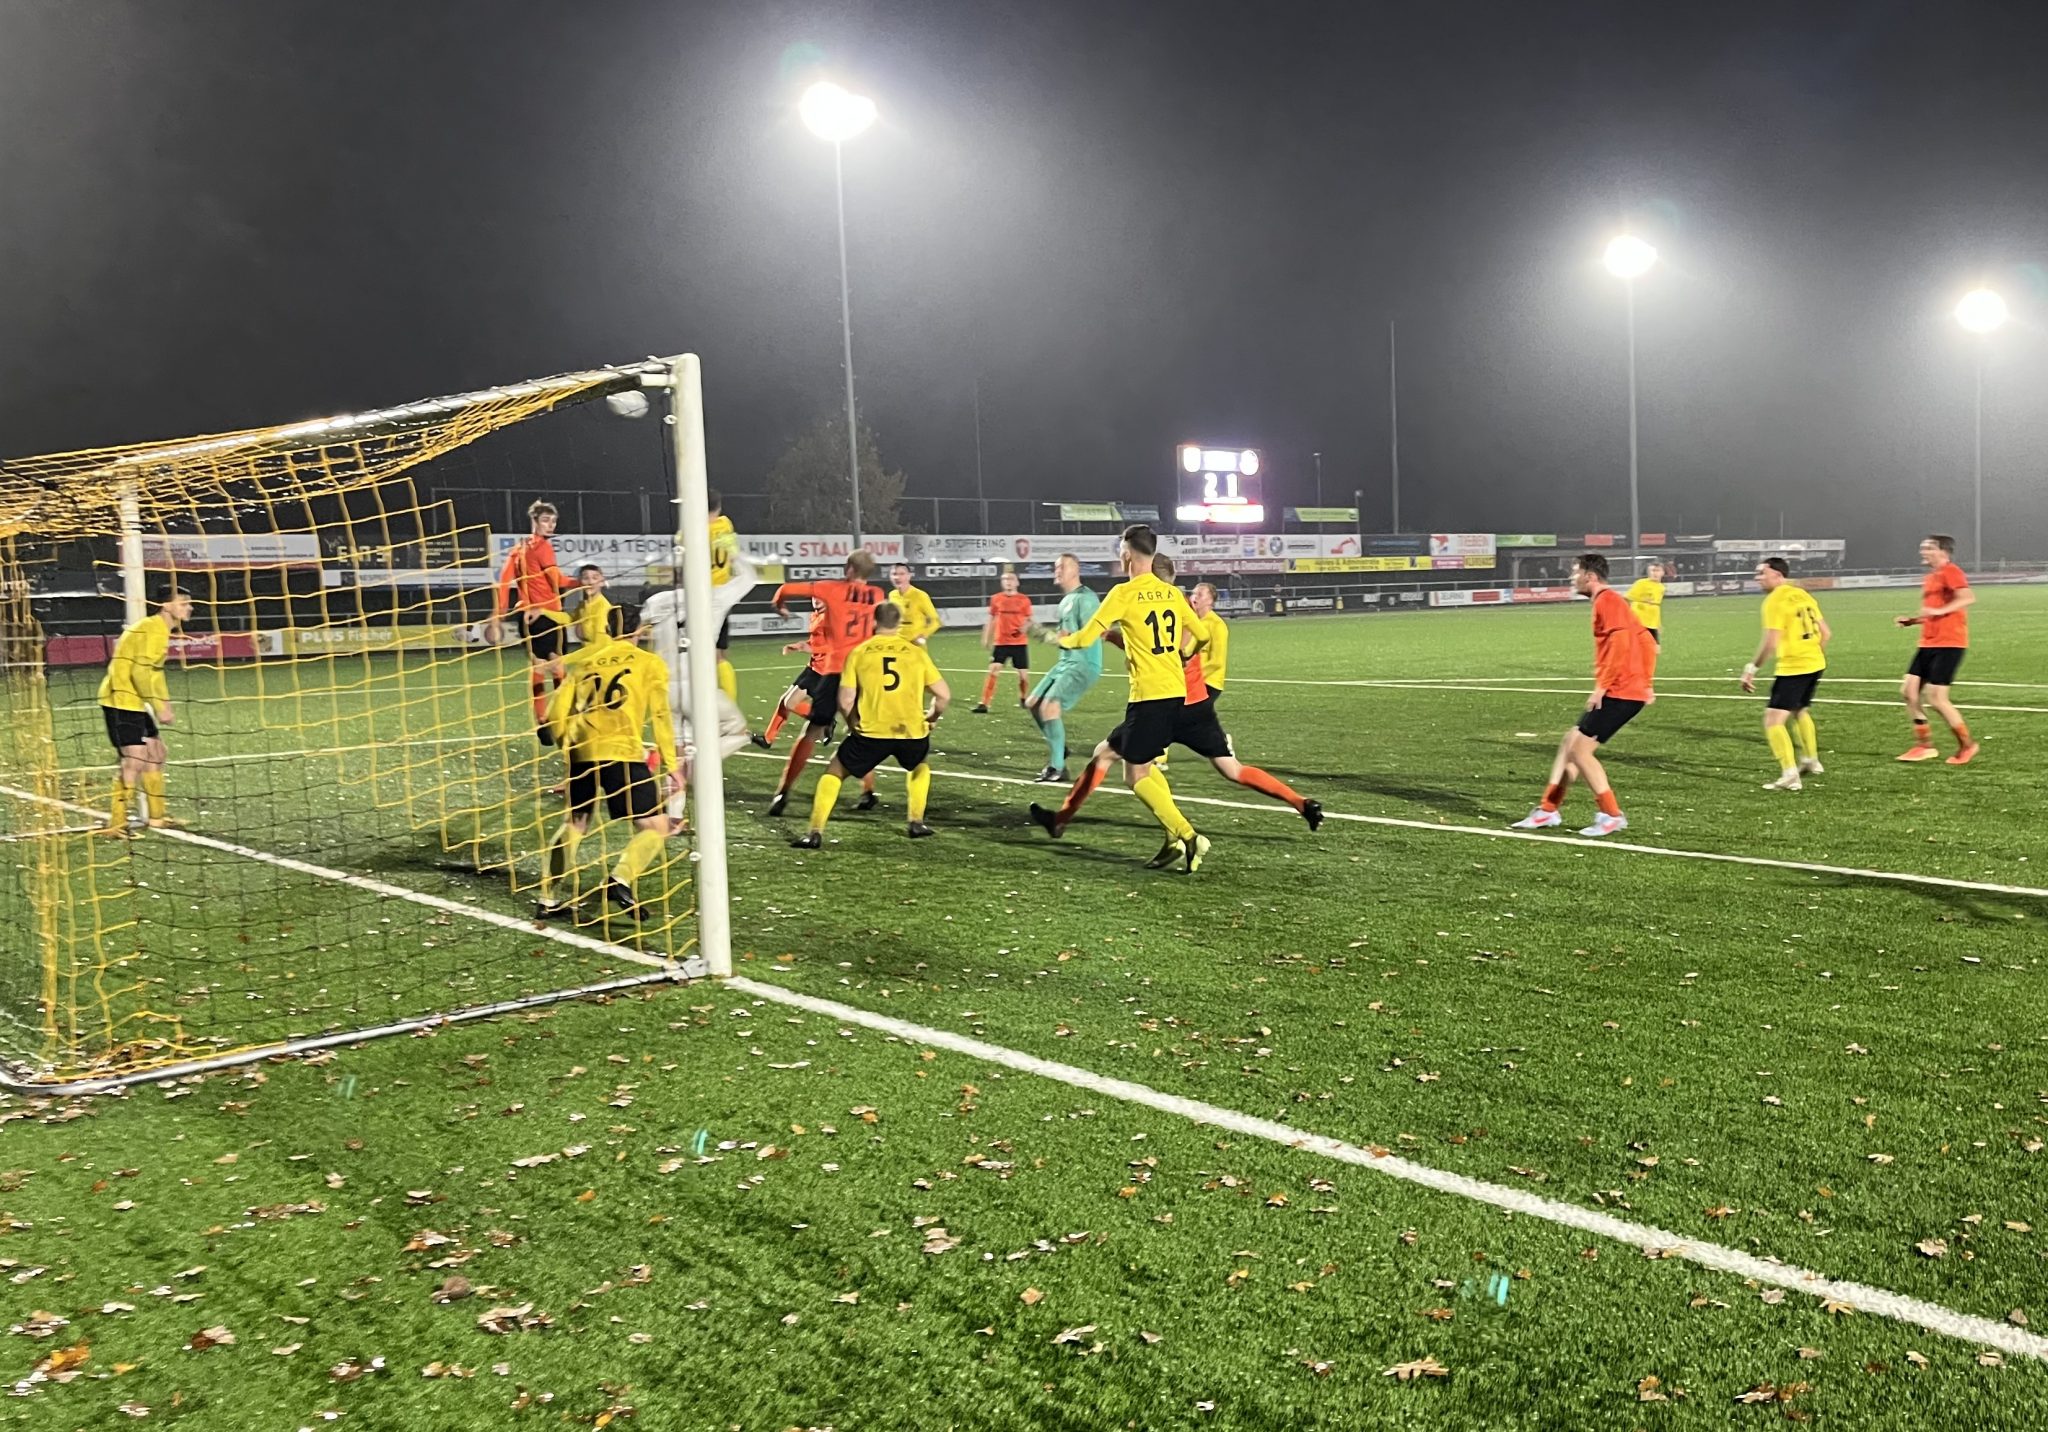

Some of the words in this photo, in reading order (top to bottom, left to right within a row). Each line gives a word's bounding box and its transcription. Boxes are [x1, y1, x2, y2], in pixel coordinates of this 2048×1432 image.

[748, 541, 794, 557] HULS
[799, 541, 901, 557] STAALOUW
[1136, 590, 1175, 601] AGRA
[1144, 609, 1177, 655] 13
[882, 656, 901, 692] 5
